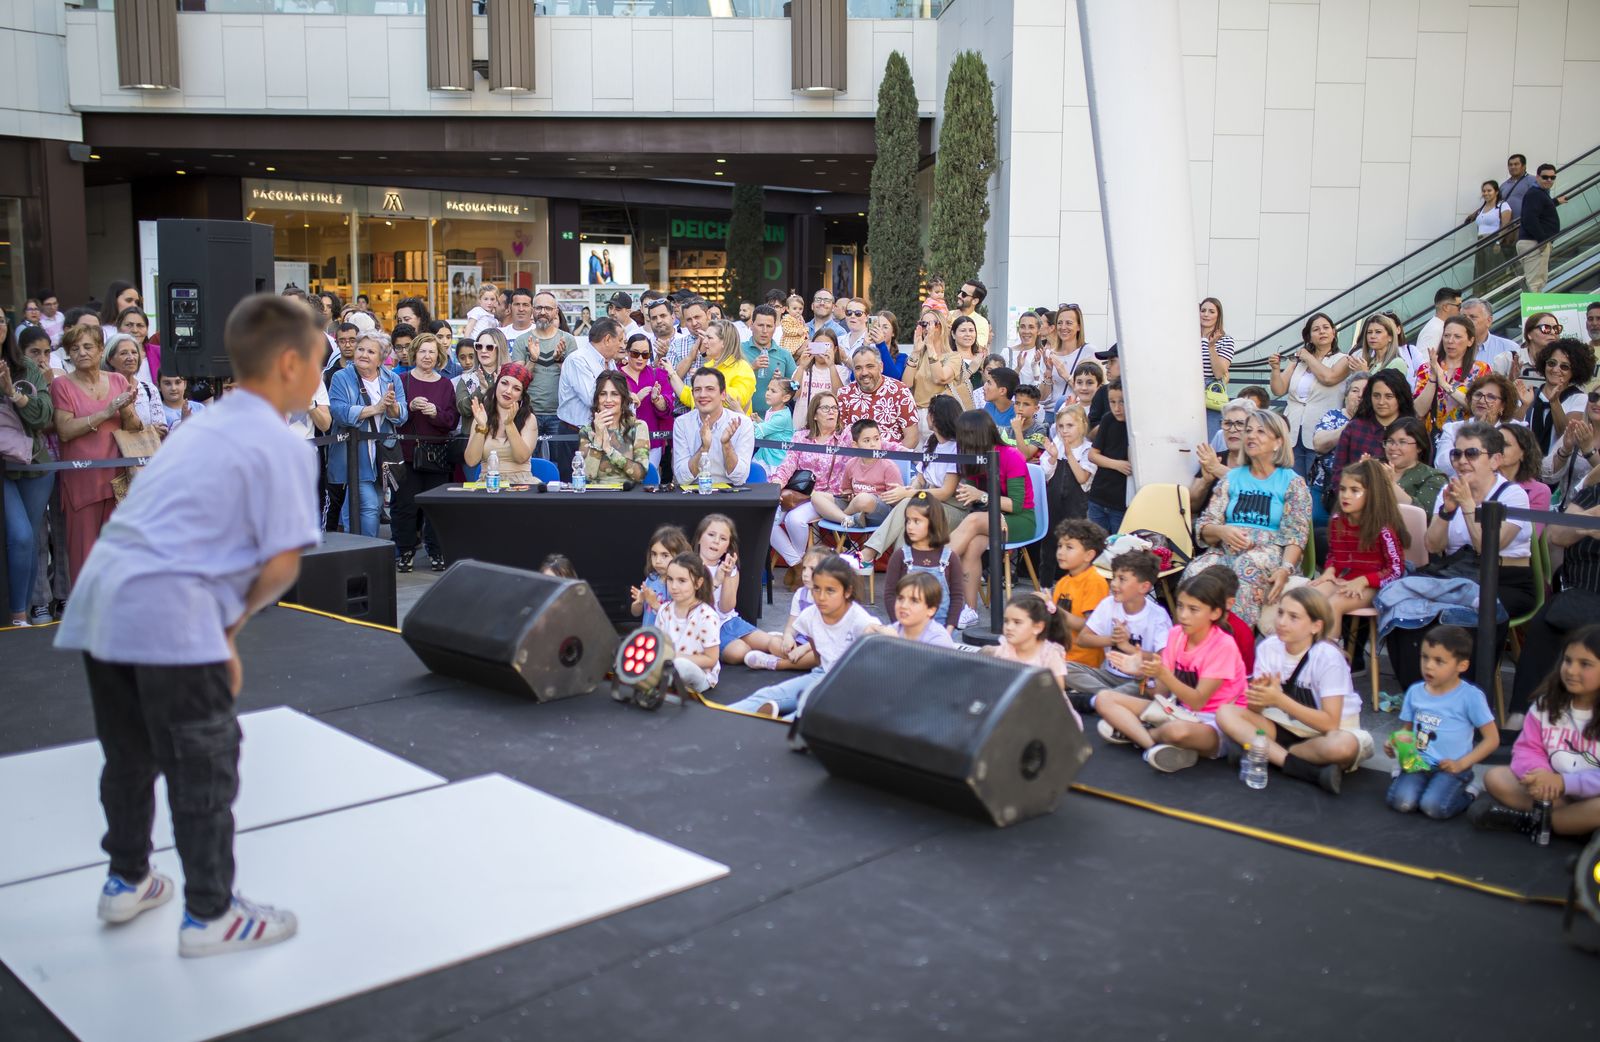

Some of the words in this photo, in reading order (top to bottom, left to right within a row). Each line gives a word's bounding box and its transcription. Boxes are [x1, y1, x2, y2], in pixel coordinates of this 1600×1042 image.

[252, 189, 343, 204] PACOMARTINEZ
[446, 201, 519, 215] PACOMARTINEZ
[671, 219, 785, 242] DEICHNN
